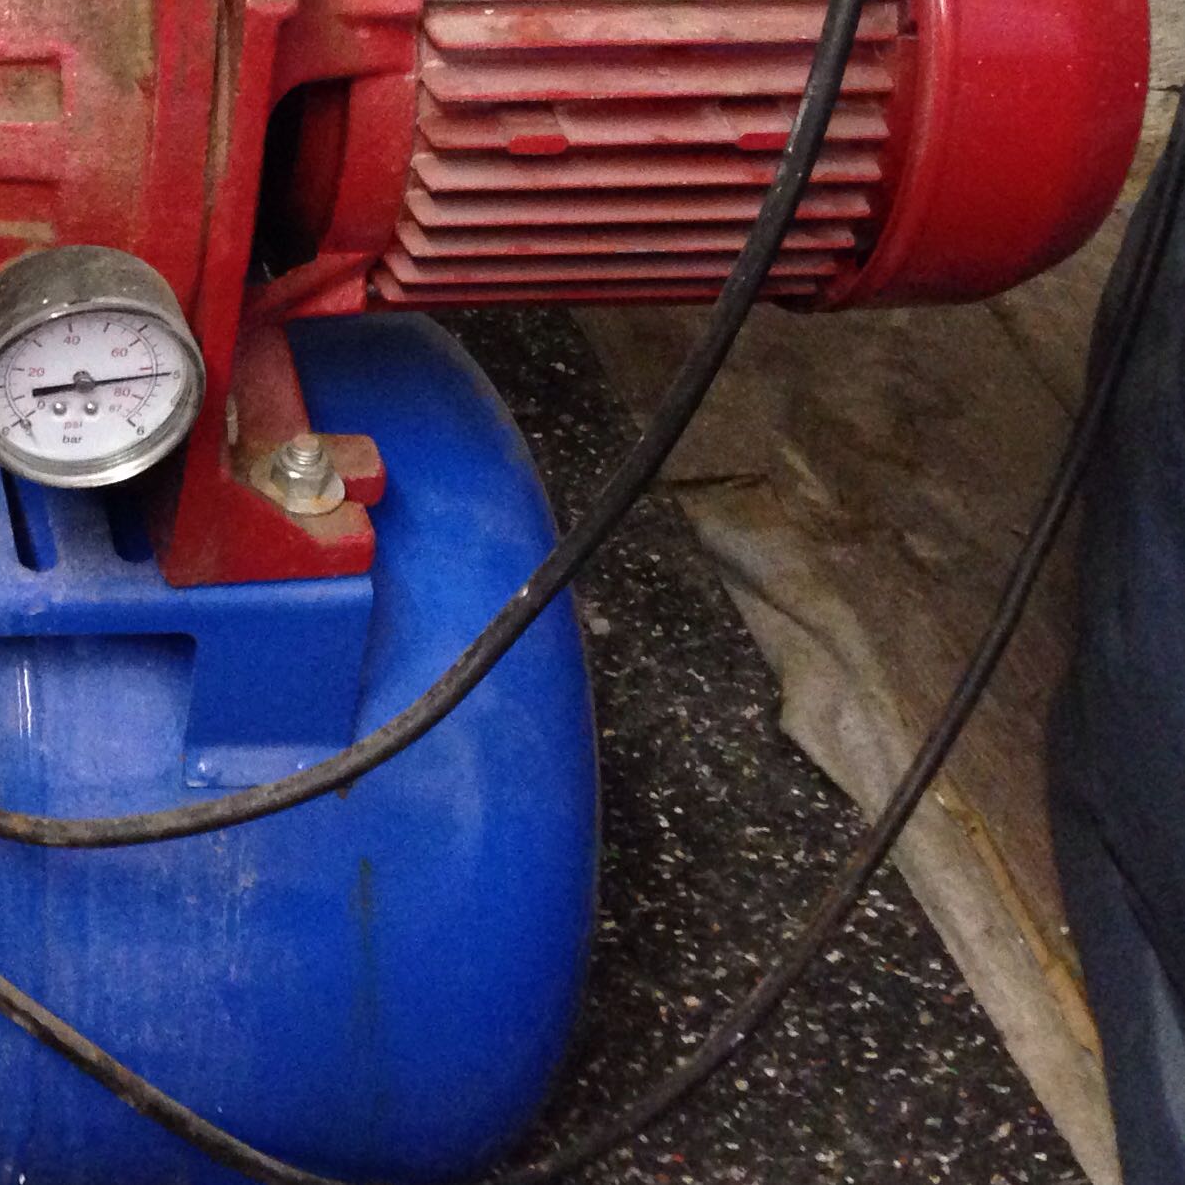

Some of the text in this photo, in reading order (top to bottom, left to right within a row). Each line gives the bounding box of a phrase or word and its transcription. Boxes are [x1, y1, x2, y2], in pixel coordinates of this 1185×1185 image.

[64, 335, 81, 346] 40
[111, 348, 129, 358] 60
[28, 367, 45, 377] 20
[114, 388, 131, 398] 80
[64, 420, 84, 430] psi
[62, 434, 84, 444] bar
